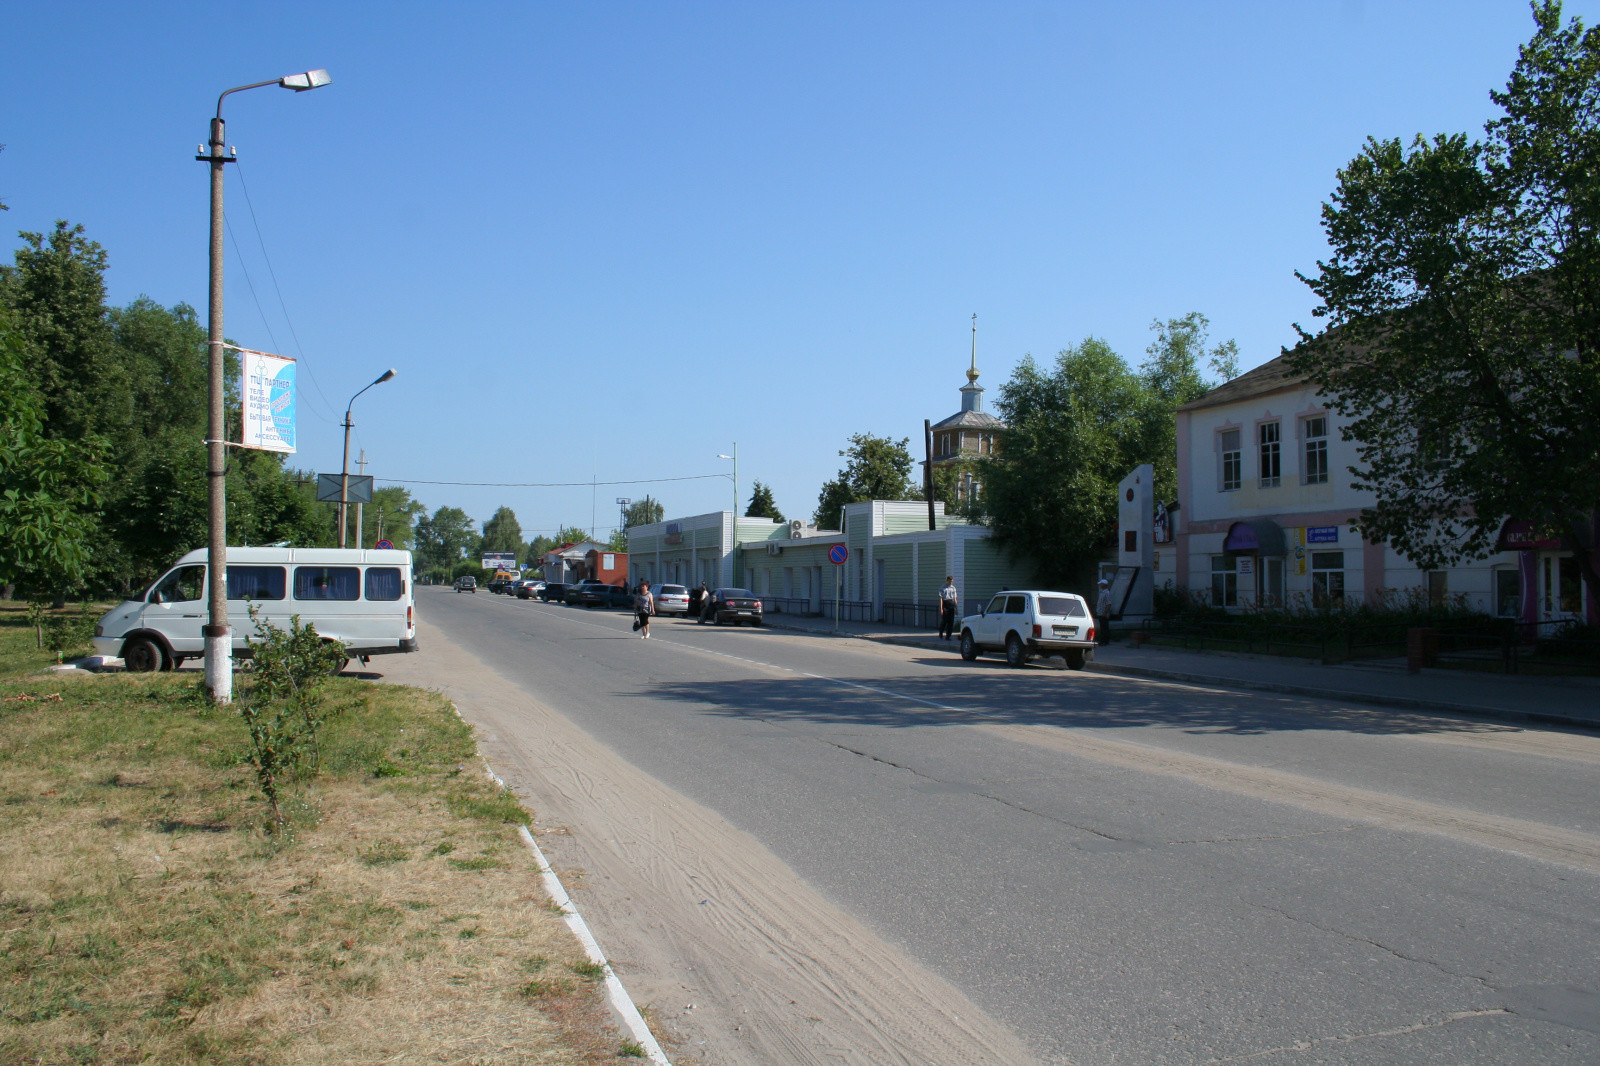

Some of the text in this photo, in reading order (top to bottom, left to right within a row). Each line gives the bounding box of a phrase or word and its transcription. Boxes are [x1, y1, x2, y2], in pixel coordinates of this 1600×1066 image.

[250, 388, 265, 396] ТЕЛЕ
[250, 395, 269, 404] ВИДЕО
[250, 402, 269, 411] АУДИО
